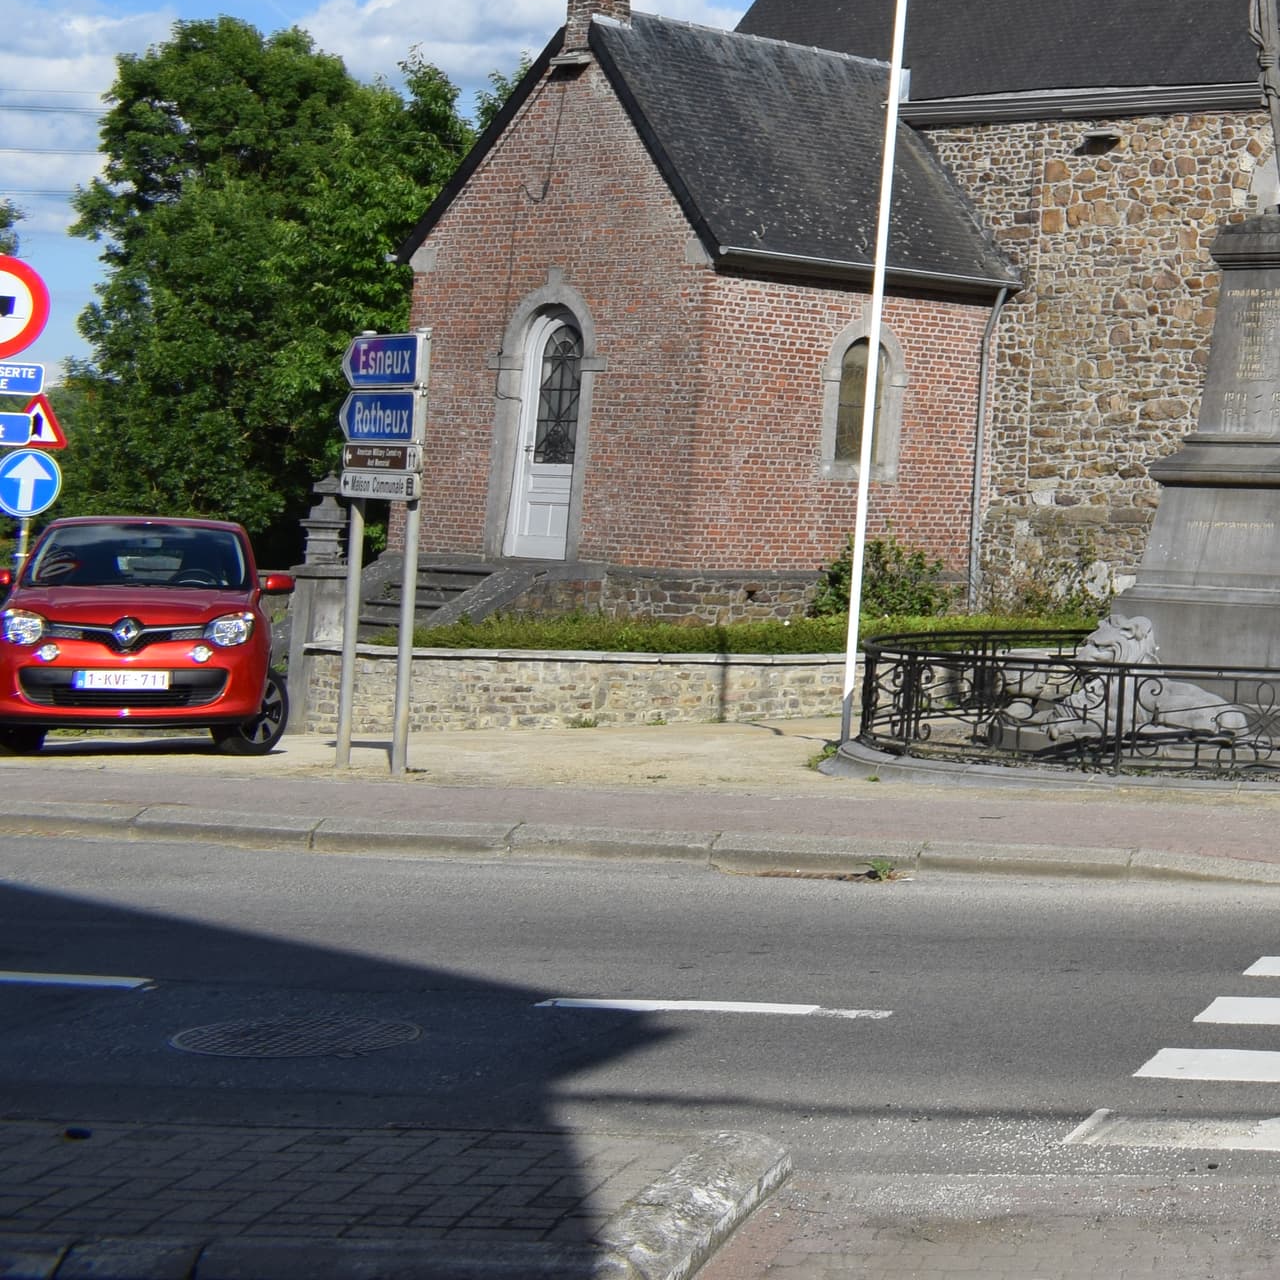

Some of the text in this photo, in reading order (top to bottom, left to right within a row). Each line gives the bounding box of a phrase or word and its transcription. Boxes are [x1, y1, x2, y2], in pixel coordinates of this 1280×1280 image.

[359, 344, 411, 375] Esneux
[354, 401, 409, 434] Rotheux
[351, 475, 404, 494] Maison Communale
